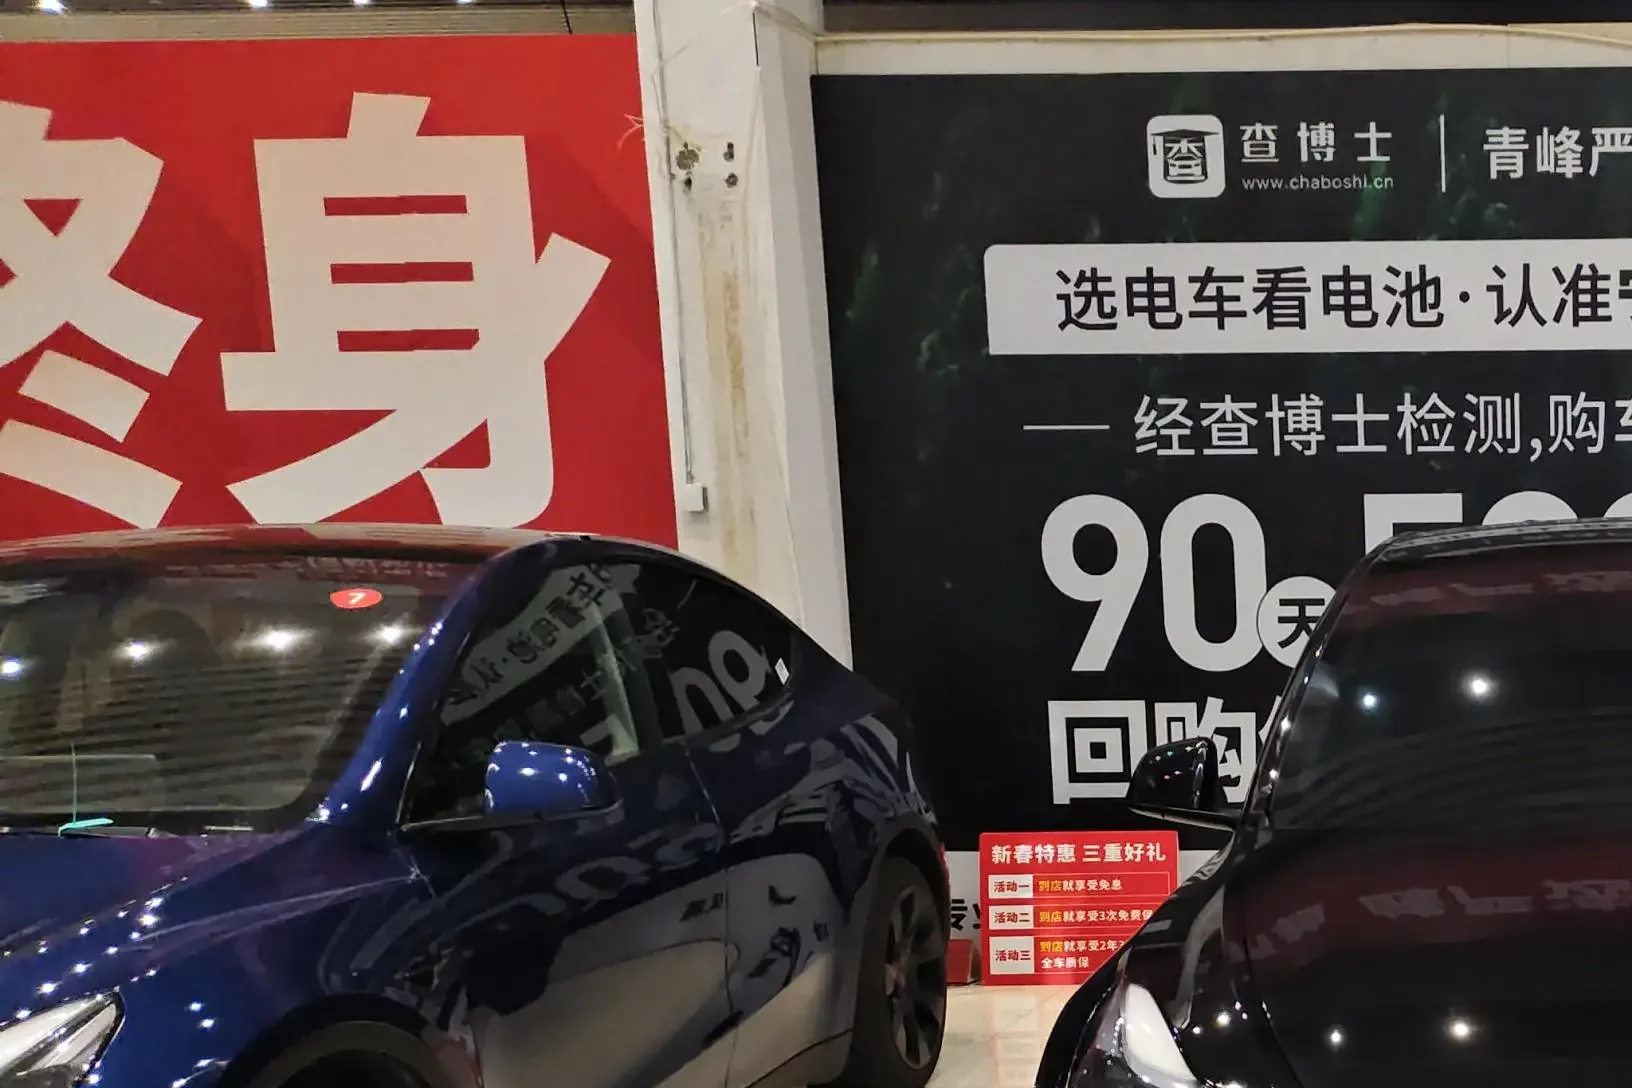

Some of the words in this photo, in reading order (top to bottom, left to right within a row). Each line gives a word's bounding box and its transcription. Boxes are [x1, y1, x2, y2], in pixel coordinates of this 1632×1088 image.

[1239, 121, 1393, 163] 查博士
[1242, 174, 1394, 190] www.chaboshi.cn
[1048, 695, 1283, 804] 回购
[991, 843, 1076, 864] 新春特惠
[1082, 842, 1166, 862] 三重好礼
[994, 880, 1030, 893] 活动一
[995, 911, 1031, 924] 活动二
[996, 949, 1031, 962] 活动三
